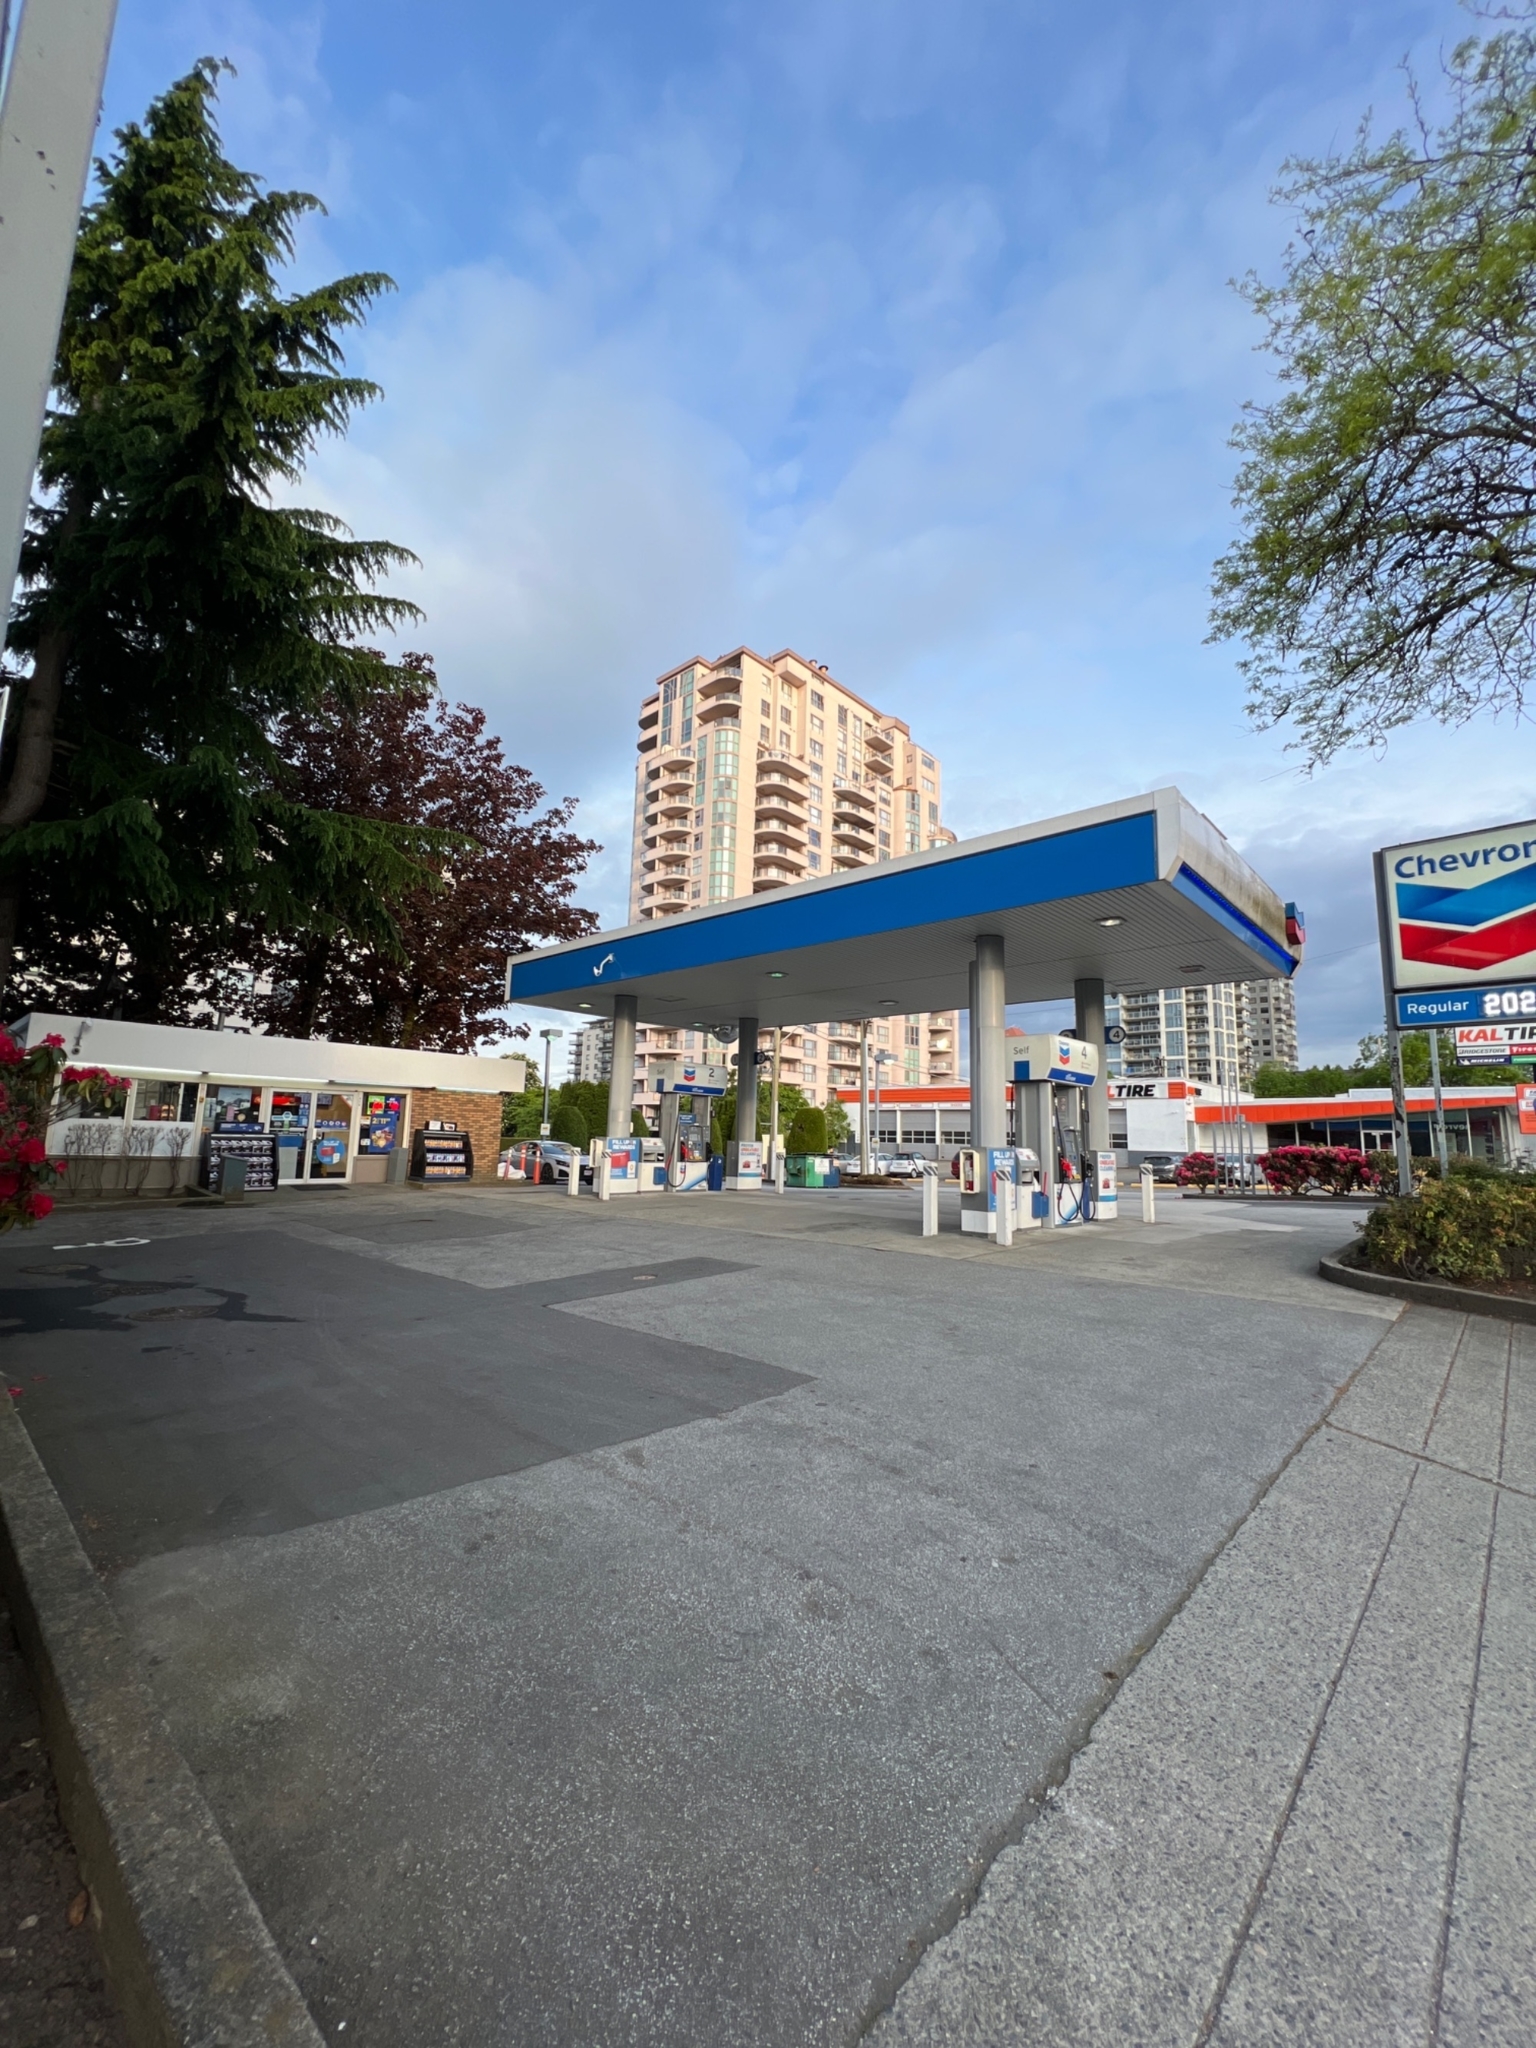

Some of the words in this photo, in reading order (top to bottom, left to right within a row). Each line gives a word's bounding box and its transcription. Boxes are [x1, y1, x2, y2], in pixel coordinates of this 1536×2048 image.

[1407, 1001, 1470, 1015] Regular
[1113, 1030, 1120, 1039] 4
[1458, 1028, 1503, 1043] KAL
[1013, 1046, 1030, 1055] Self
[1081, 1046, 1087, 1059] 4
[1458, 1047, 1507, 1055] BRIDGESTONE
[709, 1068, 715, 1078] 2
[1115, 1084, 1155, 1097] TIRE
